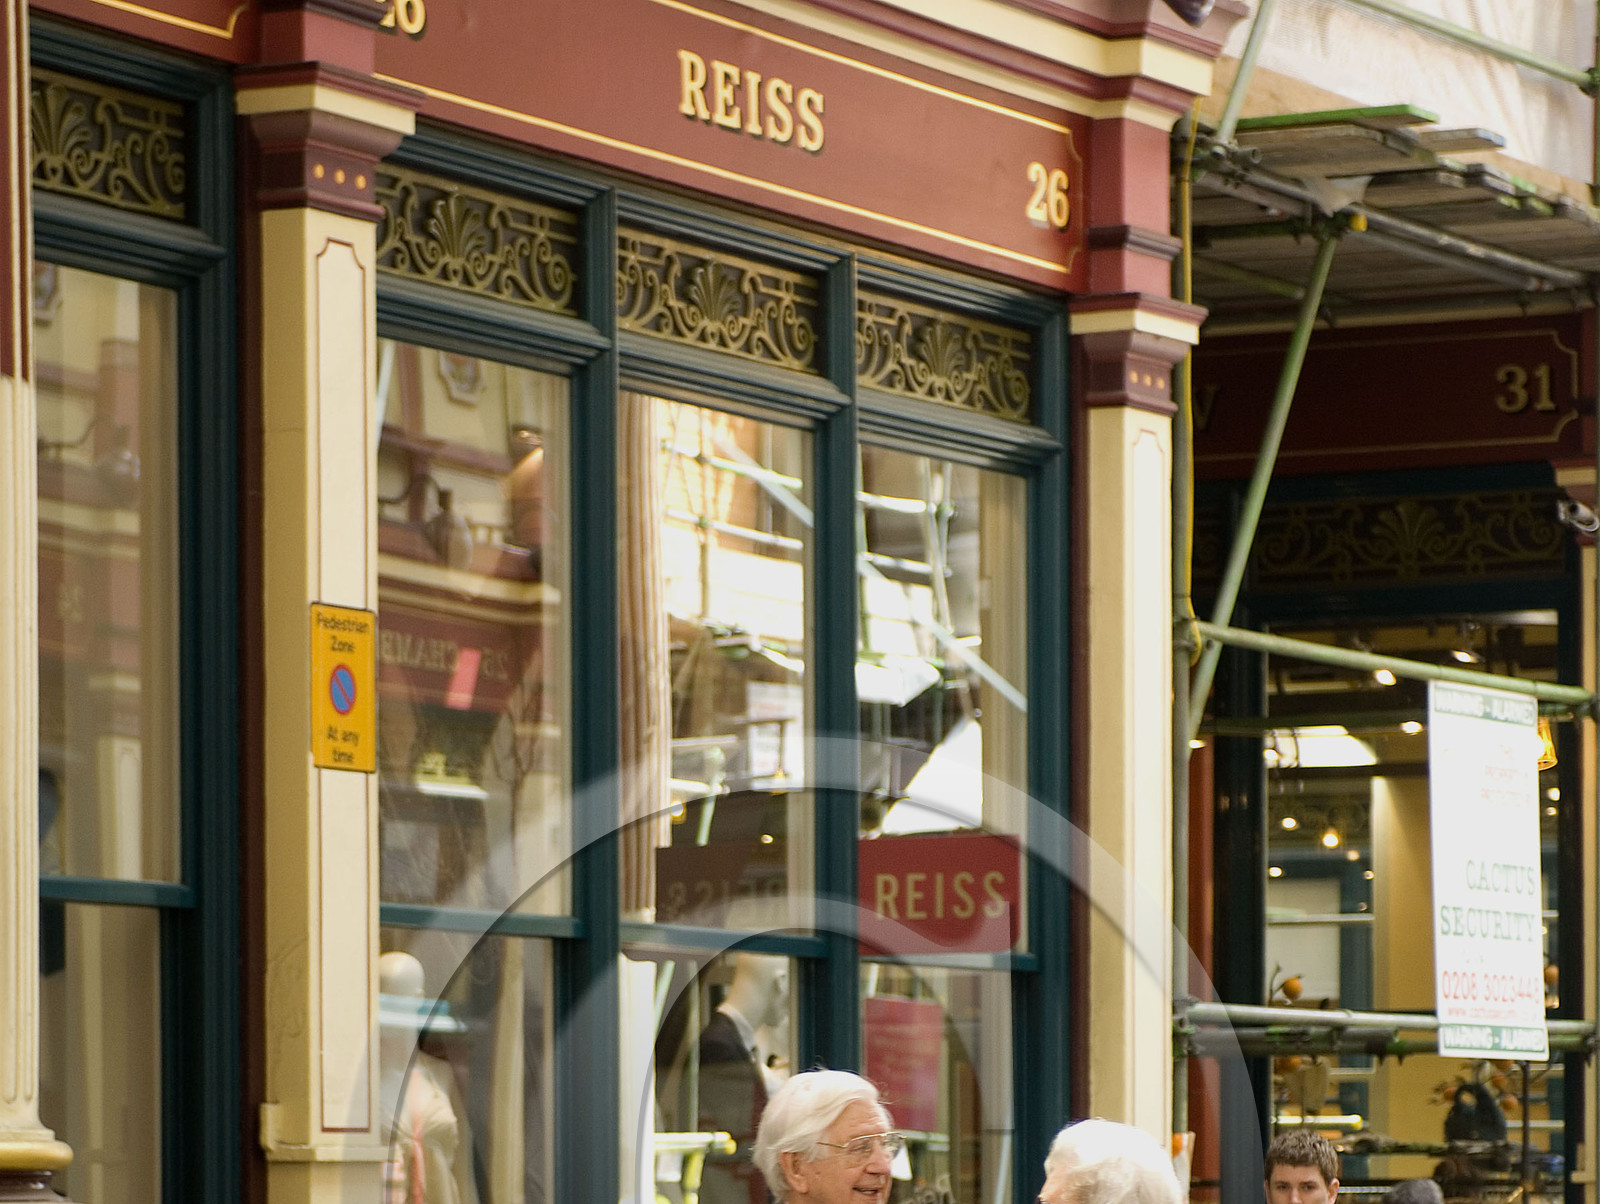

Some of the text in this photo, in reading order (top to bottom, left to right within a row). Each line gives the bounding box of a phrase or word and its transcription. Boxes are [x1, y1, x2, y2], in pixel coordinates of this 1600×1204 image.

[677, 49, 825, 152] REISS
[1025, 161, 1070, 229] 26
[1496, 363, 1556, 413] 31
[316, 611, 370, 634] Pedestrian
[331, 635, 356, 652] Zone
[332, 748, 354, 764] time
[342, 730, 360, 747] any
[1466, 860, 1535, 895] CACTUS
[875, 870, 1006, 921] REISS
[1440, 905, 1536, 941] SECURITY
[1442, 970, 1478, 1001] 0208
